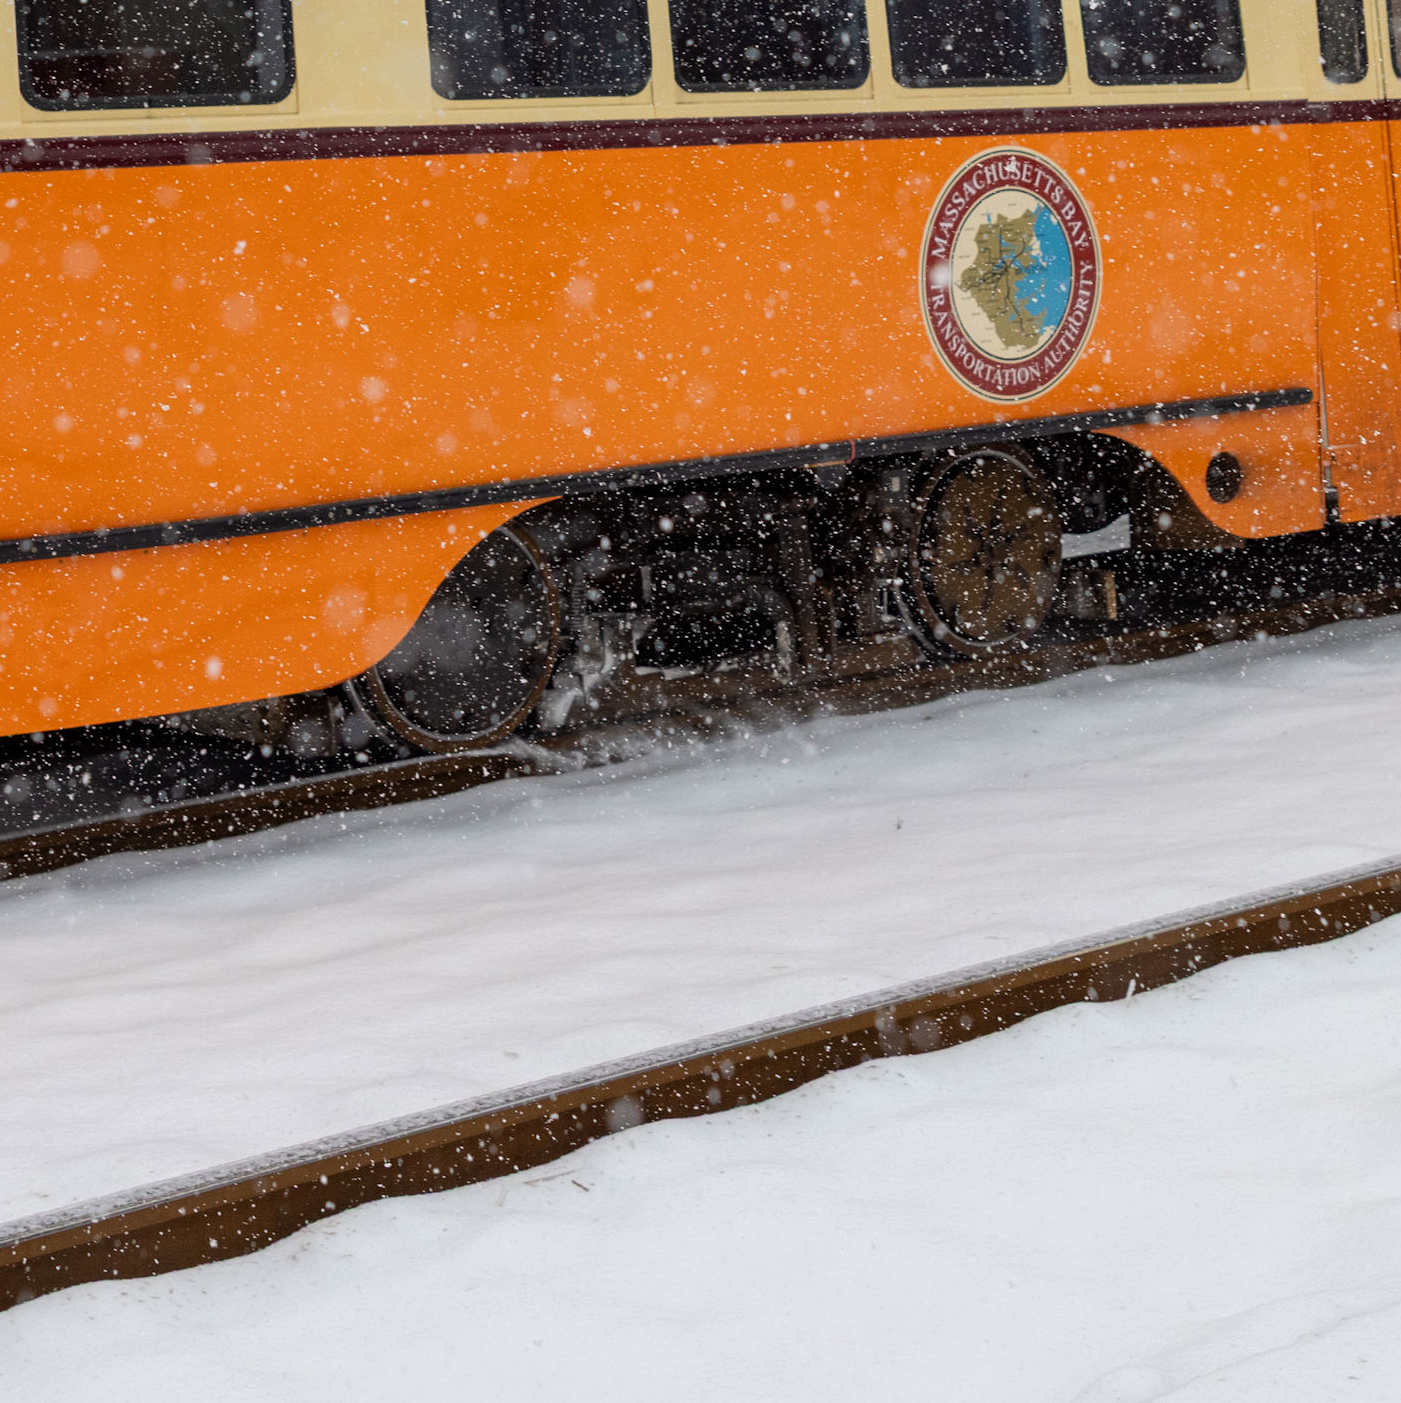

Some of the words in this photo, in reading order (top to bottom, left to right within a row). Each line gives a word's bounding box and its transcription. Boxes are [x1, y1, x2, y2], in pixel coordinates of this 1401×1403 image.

[930, 161, 1064, 259] MASSACHUSETTS
[1060, 202, 1091, 251] BAY
[929, 279, 1042, 387] TRANSPORTATION
[1044, 260, 1096, 375] AUTHORITY
